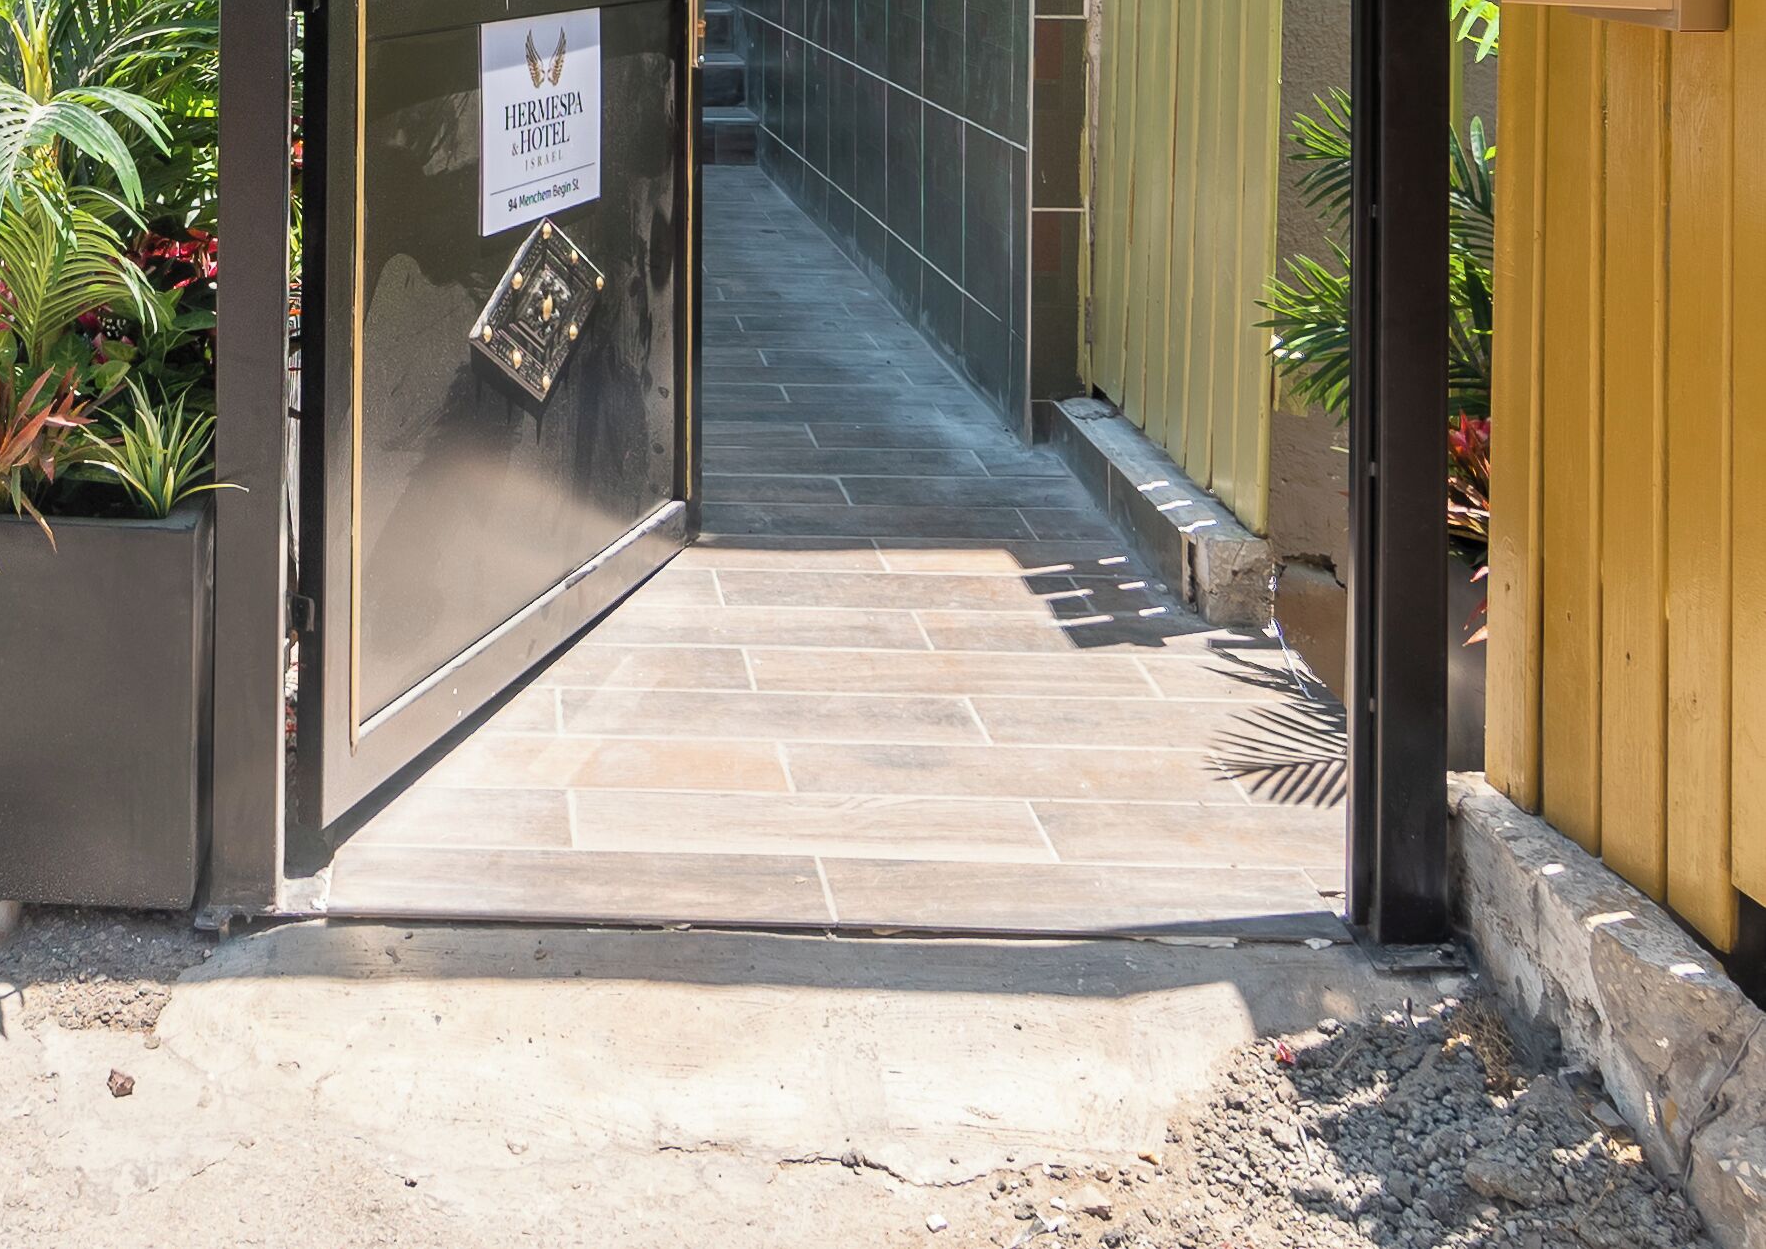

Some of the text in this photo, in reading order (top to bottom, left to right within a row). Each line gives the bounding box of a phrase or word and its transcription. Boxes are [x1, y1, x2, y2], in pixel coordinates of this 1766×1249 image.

[504, 91, 583, 131] HERMESPA
[520, 120, 570, 155] HOTEL
[525, 149, 563, 172] ISRAEL
[508, 198, 518, 211] 94
[553, 182, 572, 198] Begin
